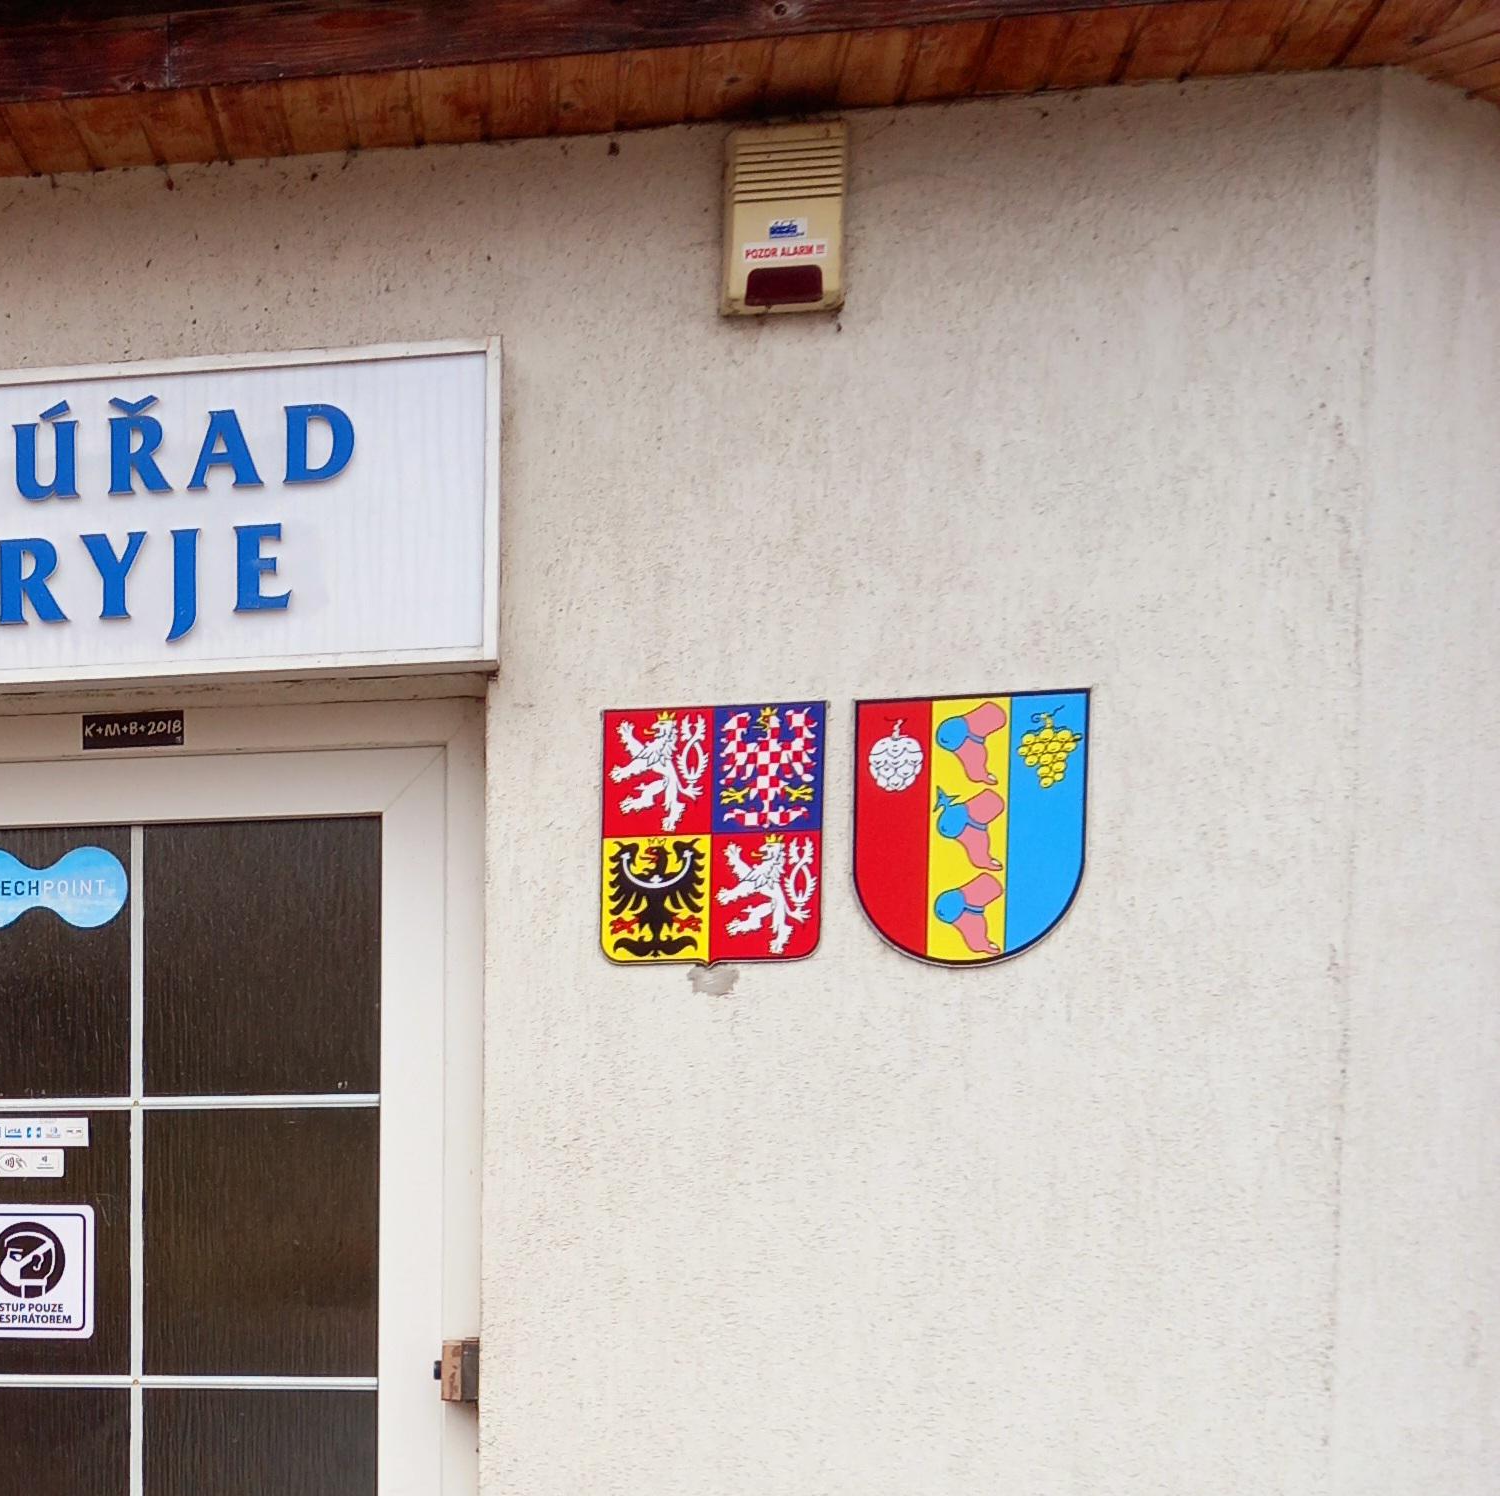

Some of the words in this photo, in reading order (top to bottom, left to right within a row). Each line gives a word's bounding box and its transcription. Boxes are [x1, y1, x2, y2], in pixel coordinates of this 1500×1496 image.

[745, 247, 778, 260] POZOR
[781, 244, 814, 257] ALARM
[12, 395, 355, 501] ÚŘAD
[28, 1303, 64, 1313] POUZE
